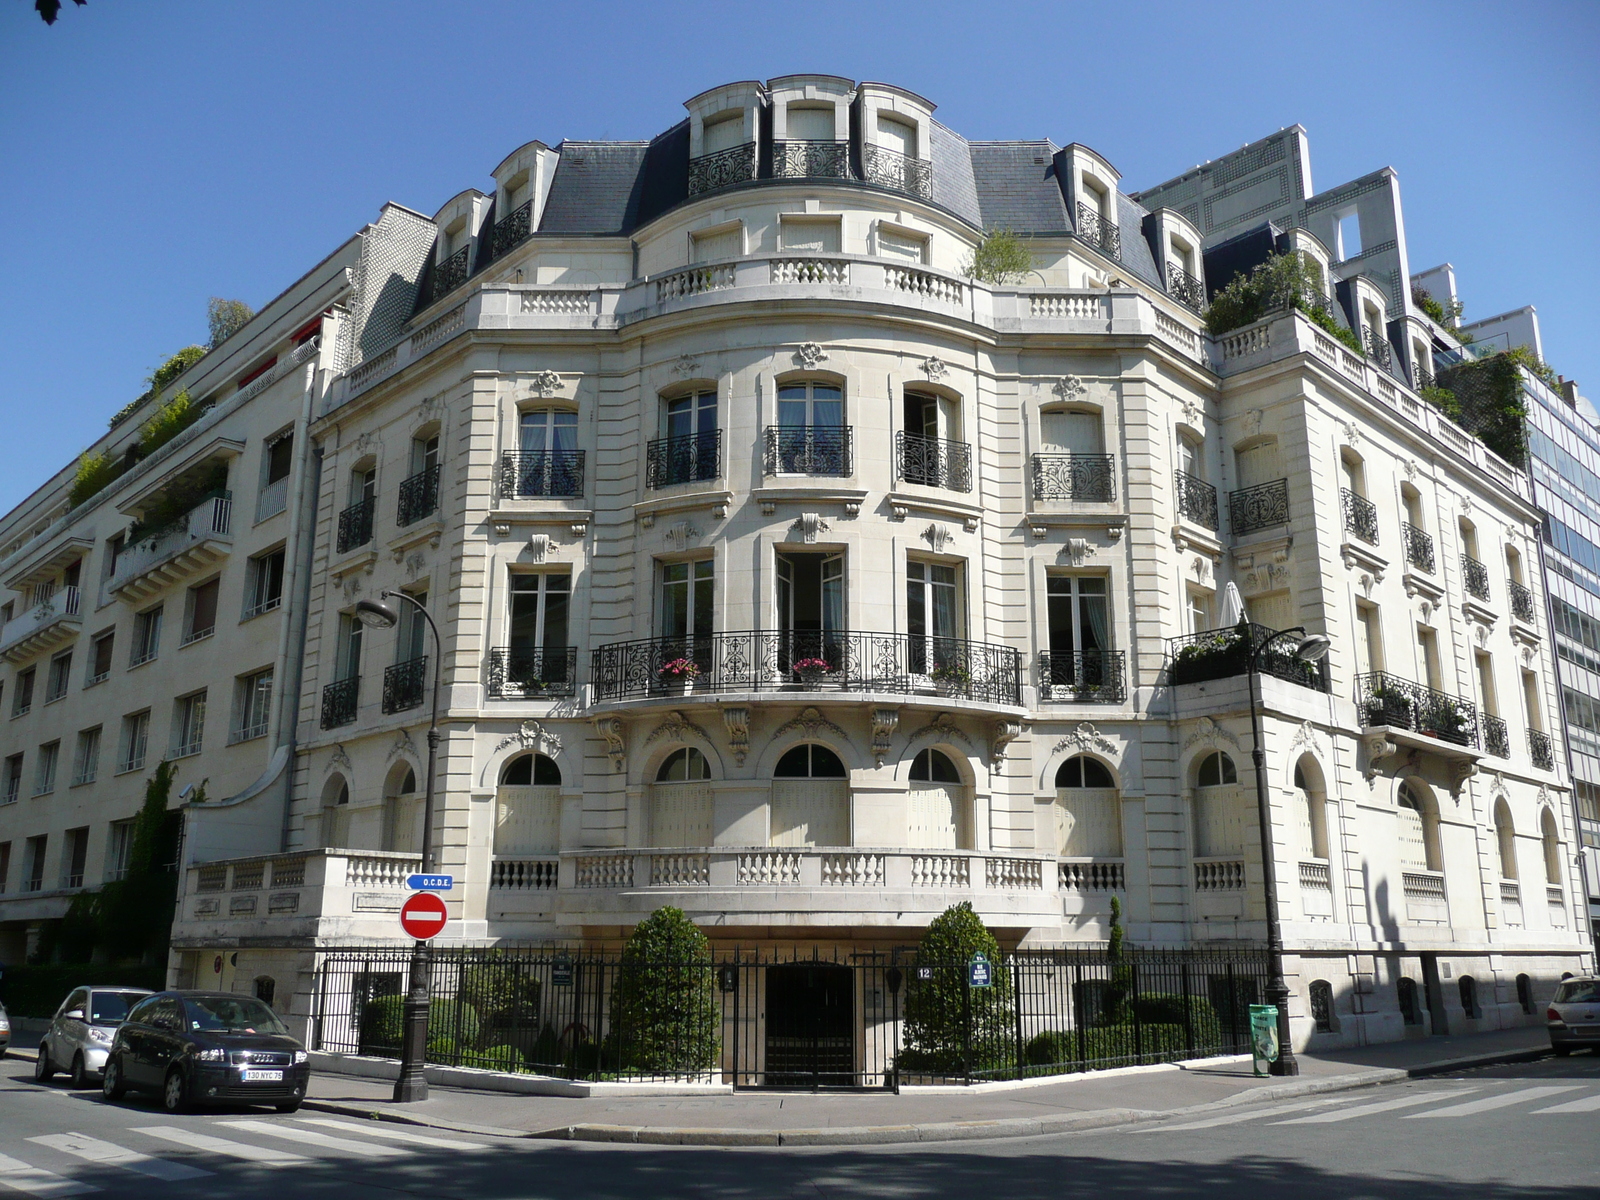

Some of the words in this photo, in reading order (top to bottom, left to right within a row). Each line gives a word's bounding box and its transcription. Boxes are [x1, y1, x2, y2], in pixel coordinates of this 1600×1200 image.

[423, 878, 451, 887] O.C.D.E.
[919, 968, 930, 978] 12
[247, 1071, 260, 1079] 130
